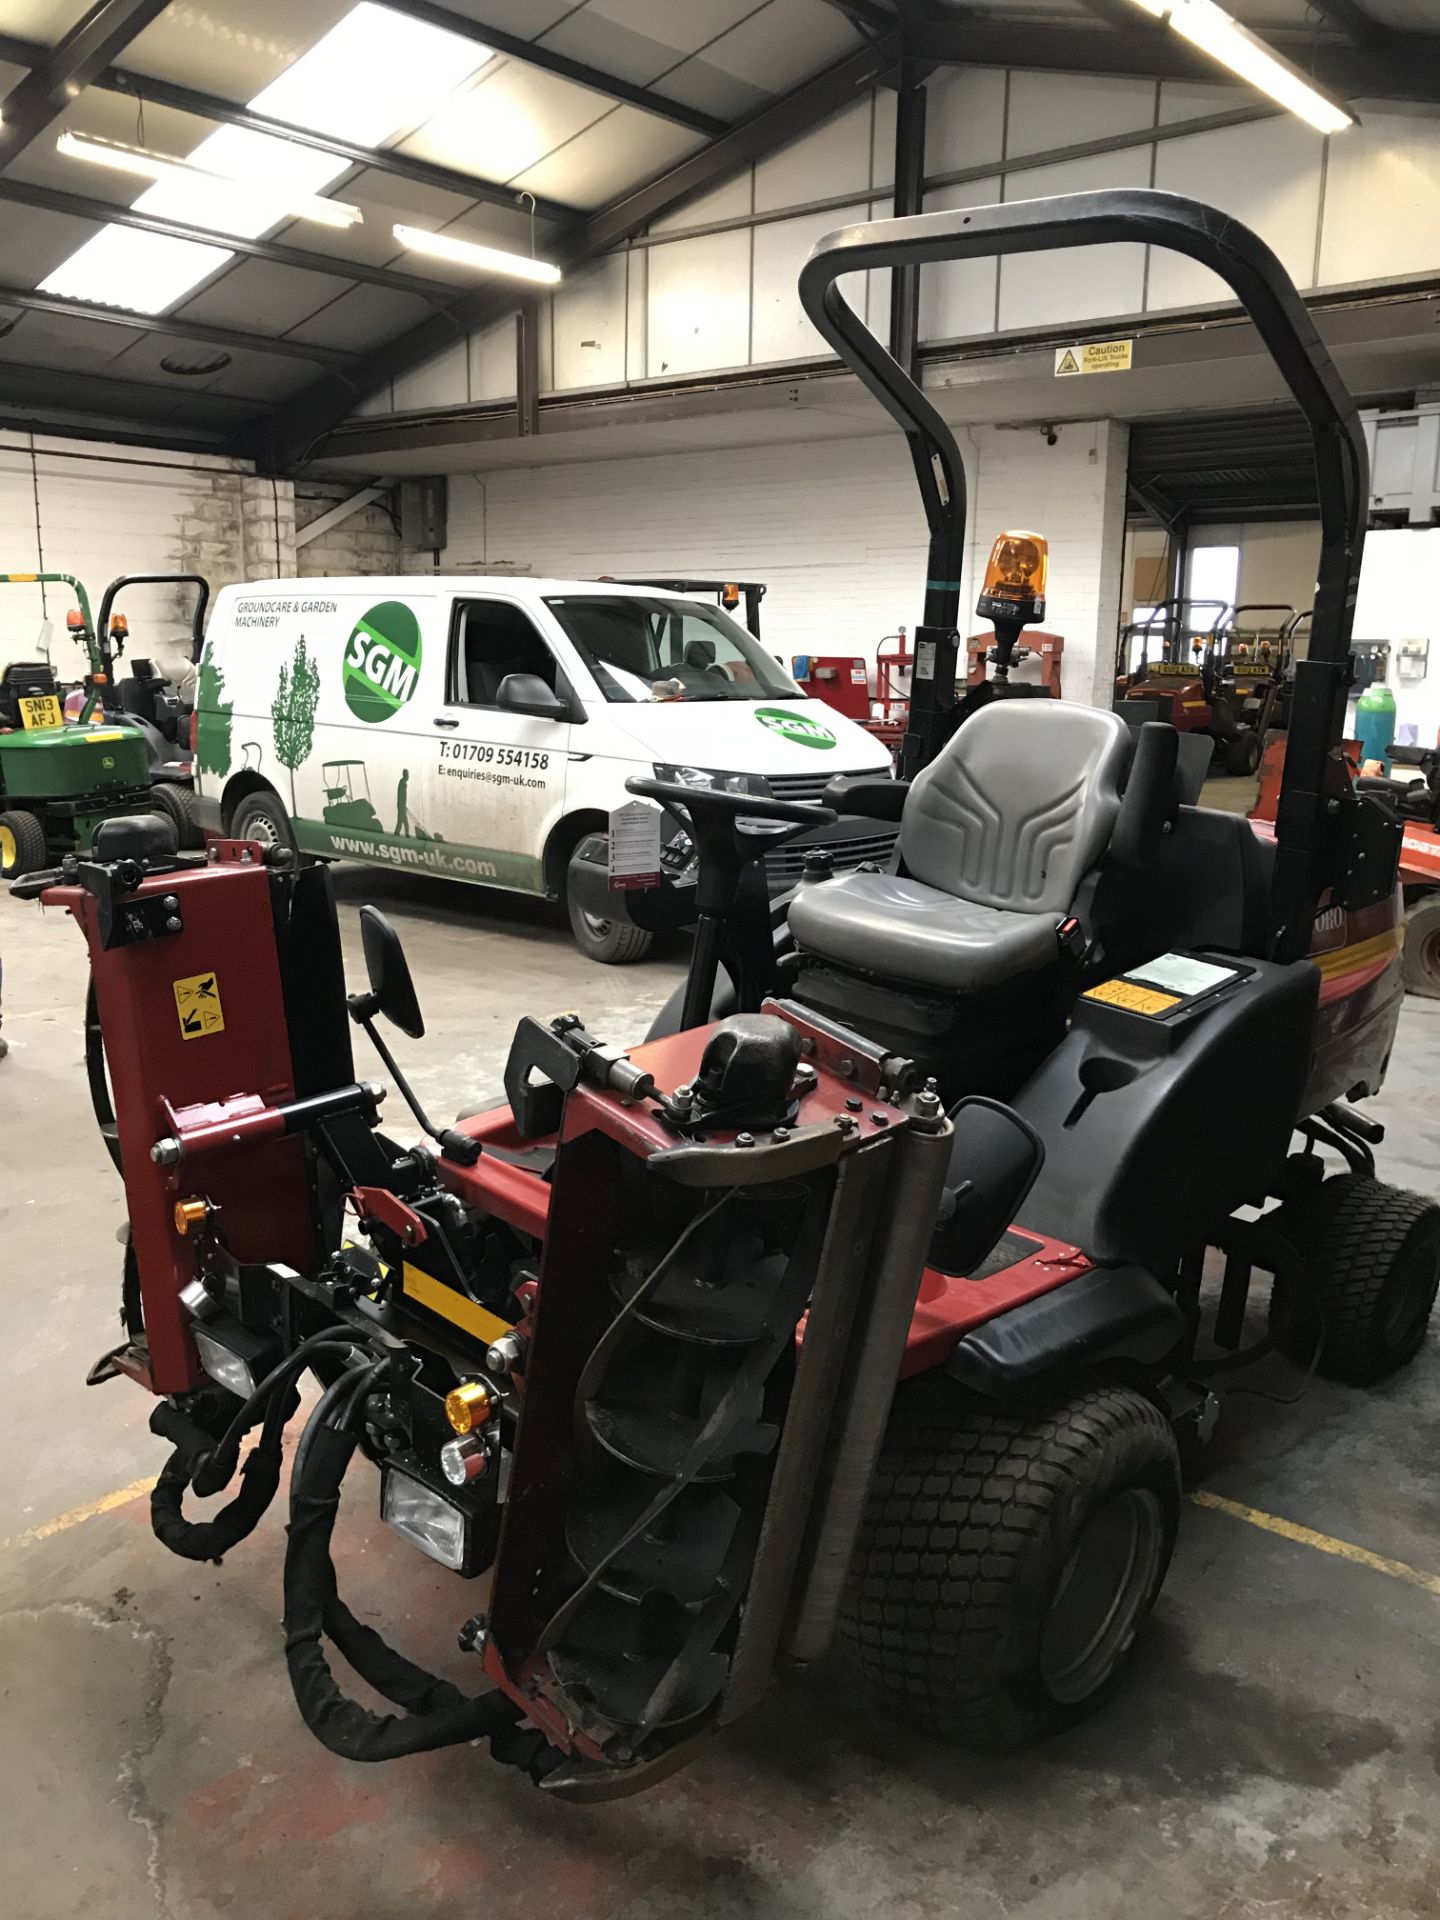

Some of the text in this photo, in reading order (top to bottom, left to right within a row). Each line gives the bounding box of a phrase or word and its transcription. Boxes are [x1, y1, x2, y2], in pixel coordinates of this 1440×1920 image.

[1088, 345, 1125, 356] Caution
[237, 601, 338, 613] GROUNDCARE & GARDEN
[234, 616, 280, 628] MACHINERY
[346, 631, 414, 700] SGM
[25, 698, 53, 712] SN13
[761, 716, 833, 741] SGM
[439, 741, 550, 771] T: 01709 554158
[438, 764, 546, 790] E: enquiries@sgm-uk.com
[330, 835, 497, 877] www.sgm-uk.com
[1314, 906, 1343, 933] ORO
